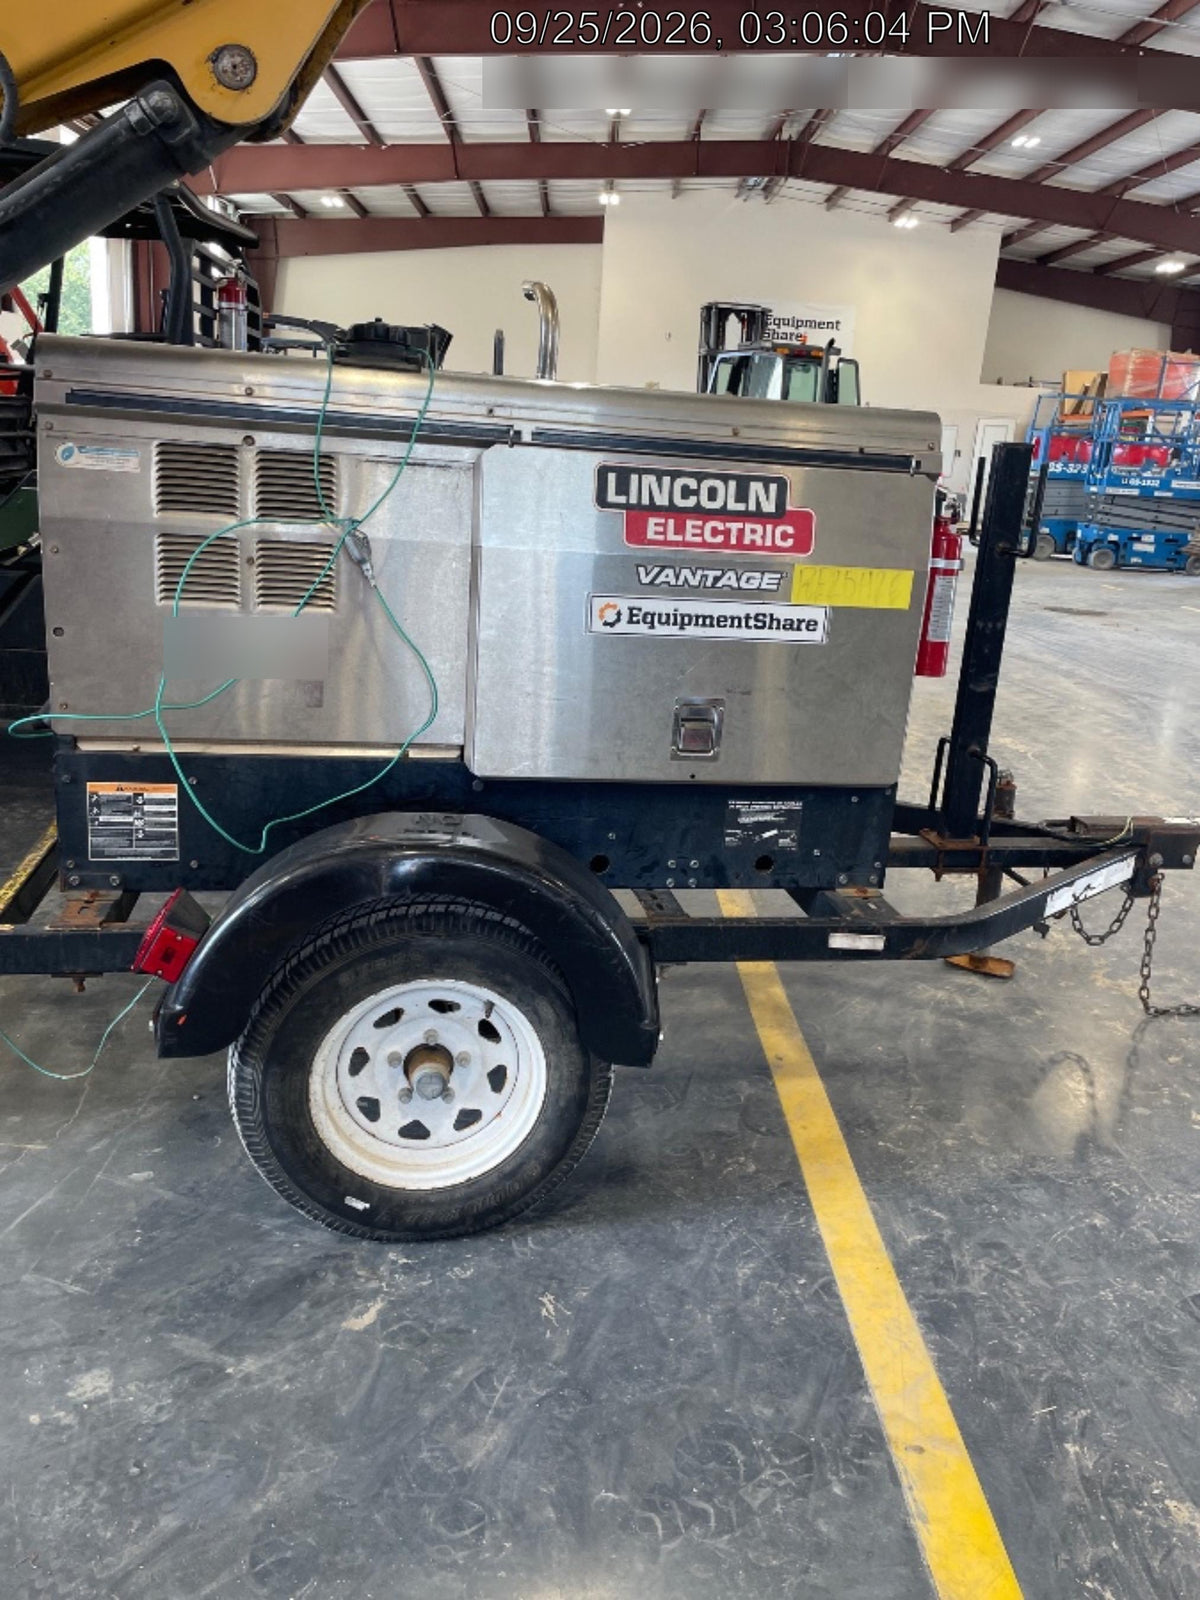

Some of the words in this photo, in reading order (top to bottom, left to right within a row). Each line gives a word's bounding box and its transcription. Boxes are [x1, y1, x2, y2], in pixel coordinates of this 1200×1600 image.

[766, 313, 842, 331] Equipment
[606, 471, 778, 513] LINCOLN
[646, 517, 795, 547] ELECTRIC
[636, 564, 784, 591] VANTAGE
[627, 607, 818, 632] EquipmentShare
